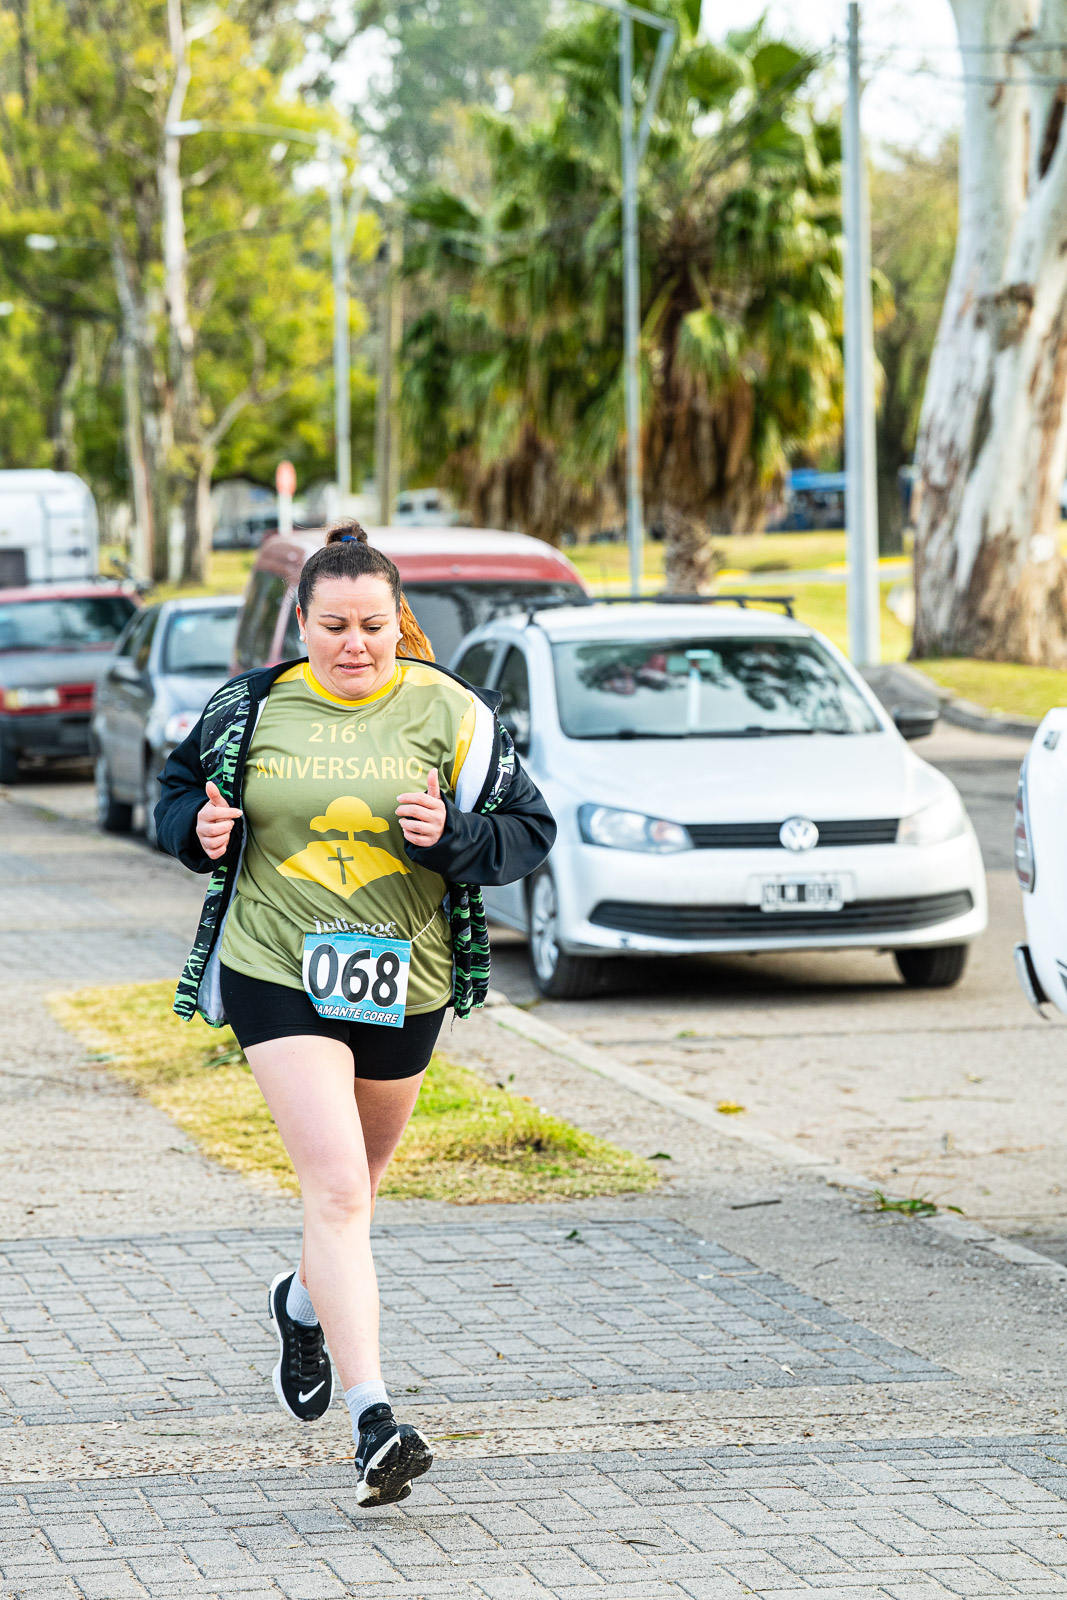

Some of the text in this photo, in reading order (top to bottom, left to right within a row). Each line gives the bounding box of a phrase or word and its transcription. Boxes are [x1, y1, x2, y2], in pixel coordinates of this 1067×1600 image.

[256, 756, 423, 780] ANIVERSARIO
[308, 943, 400, 1008] 068
[313, 1003, 399, 1024] IAMANTE CORRE
